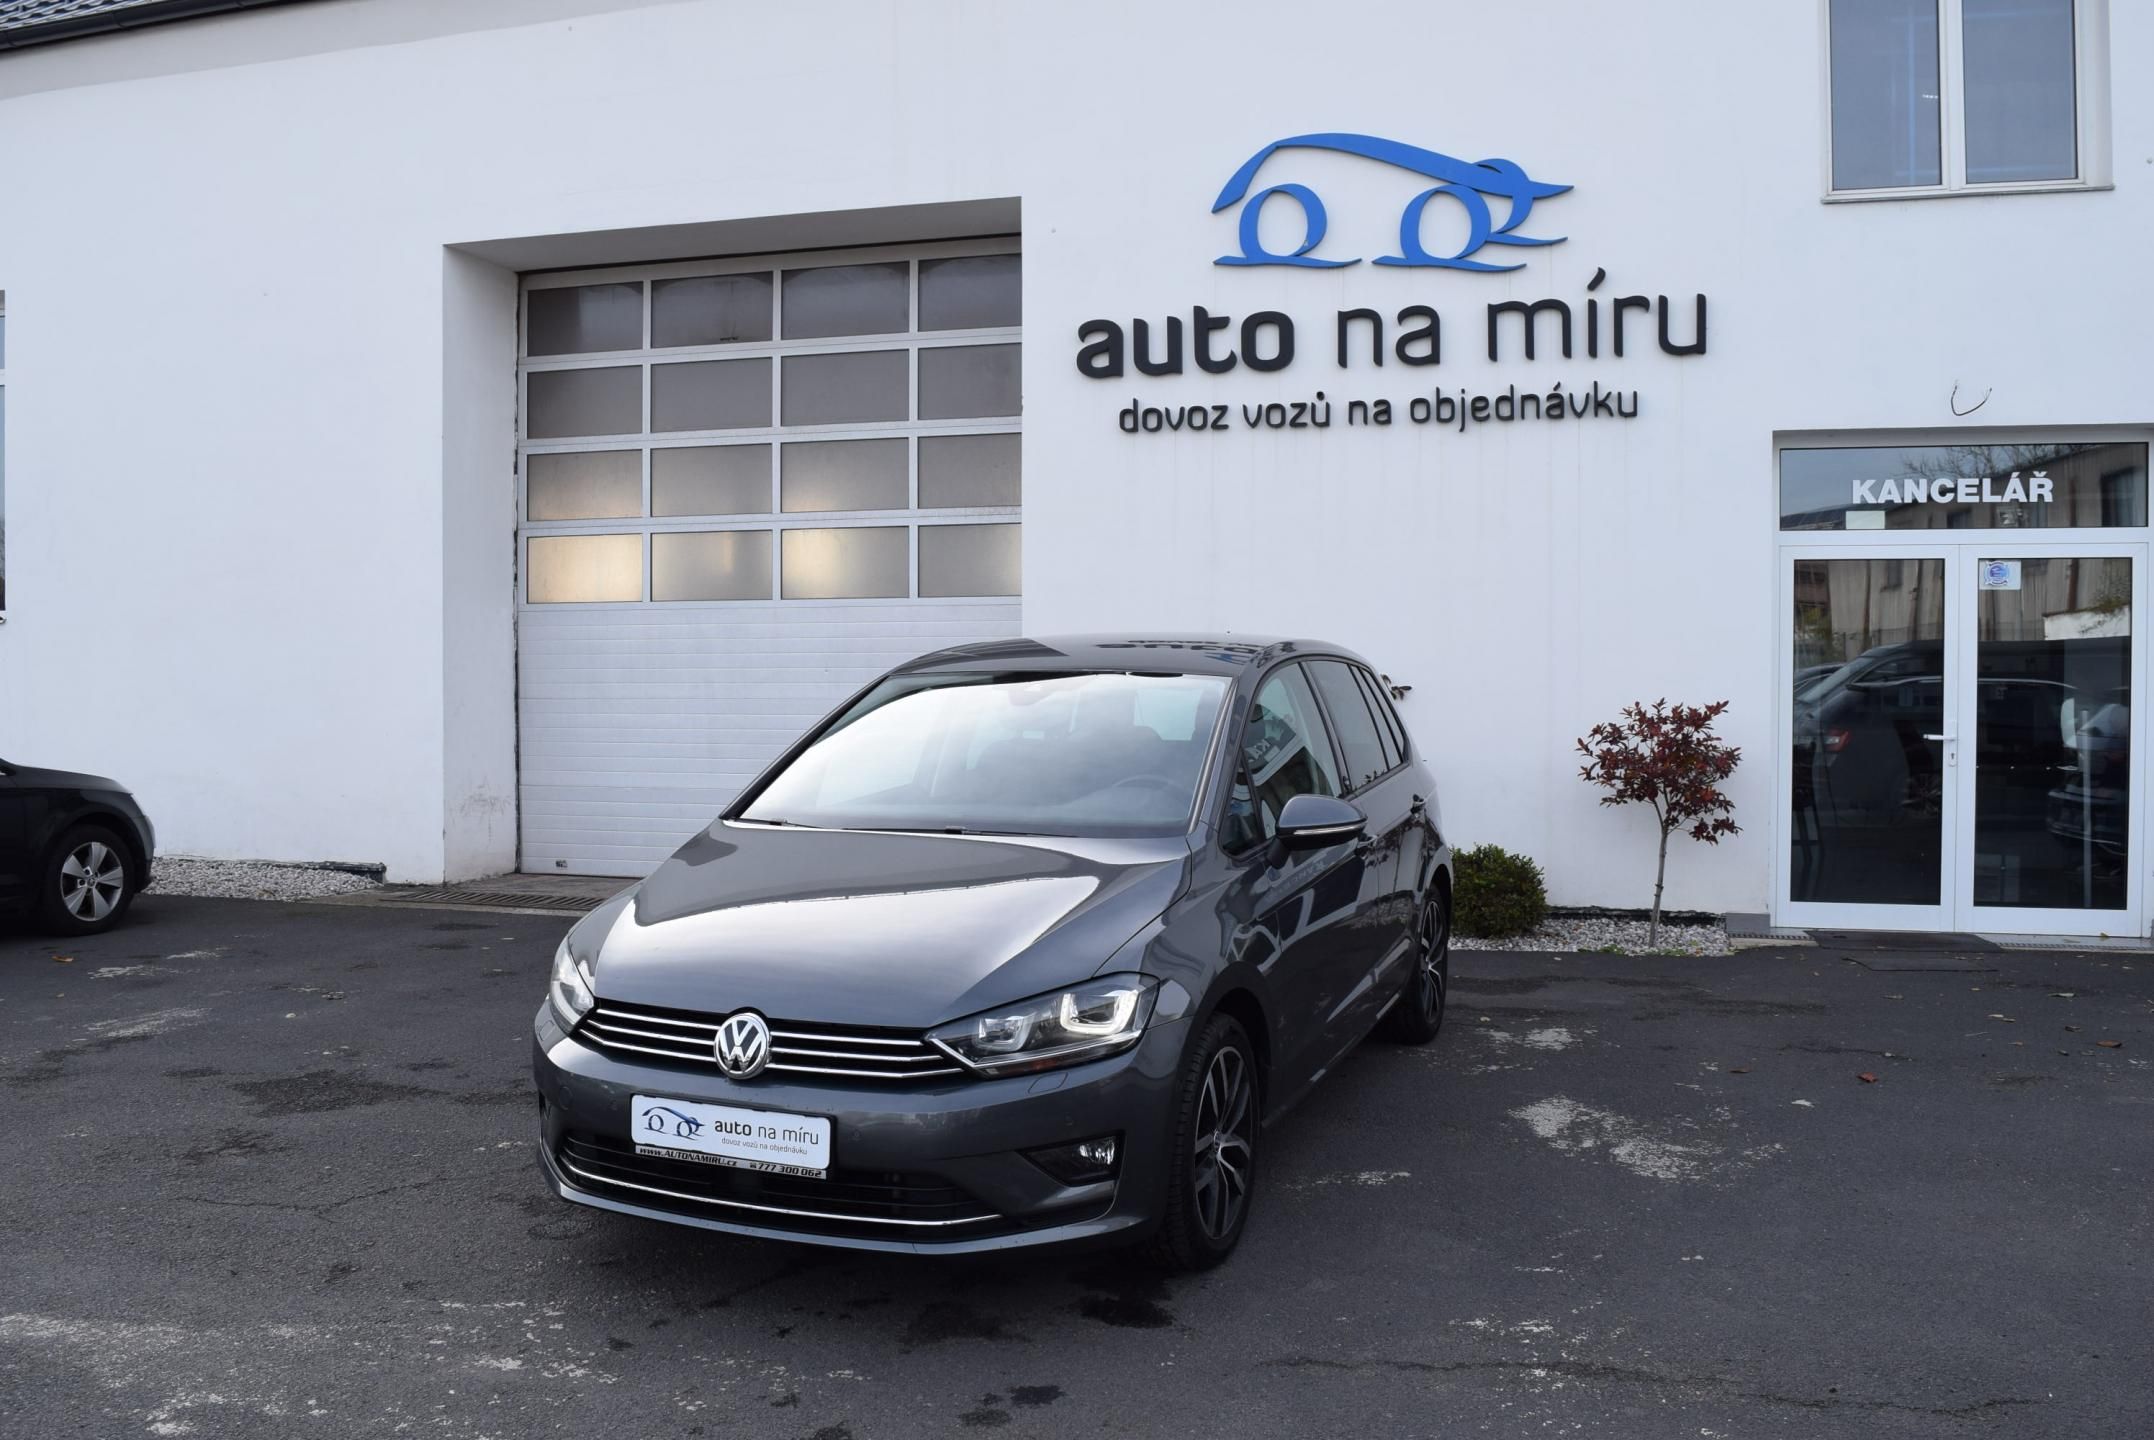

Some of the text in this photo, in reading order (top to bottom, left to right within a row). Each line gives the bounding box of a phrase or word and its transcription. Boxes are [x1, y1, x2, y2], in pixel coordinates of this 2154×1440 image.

[1076, 266, 1707, 379] auto na míru
[1119, 380, 1638, 433] dovoz vozů na objednávku
[1852, 471, 2053, 504] KANCELÁŘ
[714, 1120, 819, 1145] auto na míru
[721, 1137, 741, 1147] dovoz
[801, 1168, 822, 1178] 062
